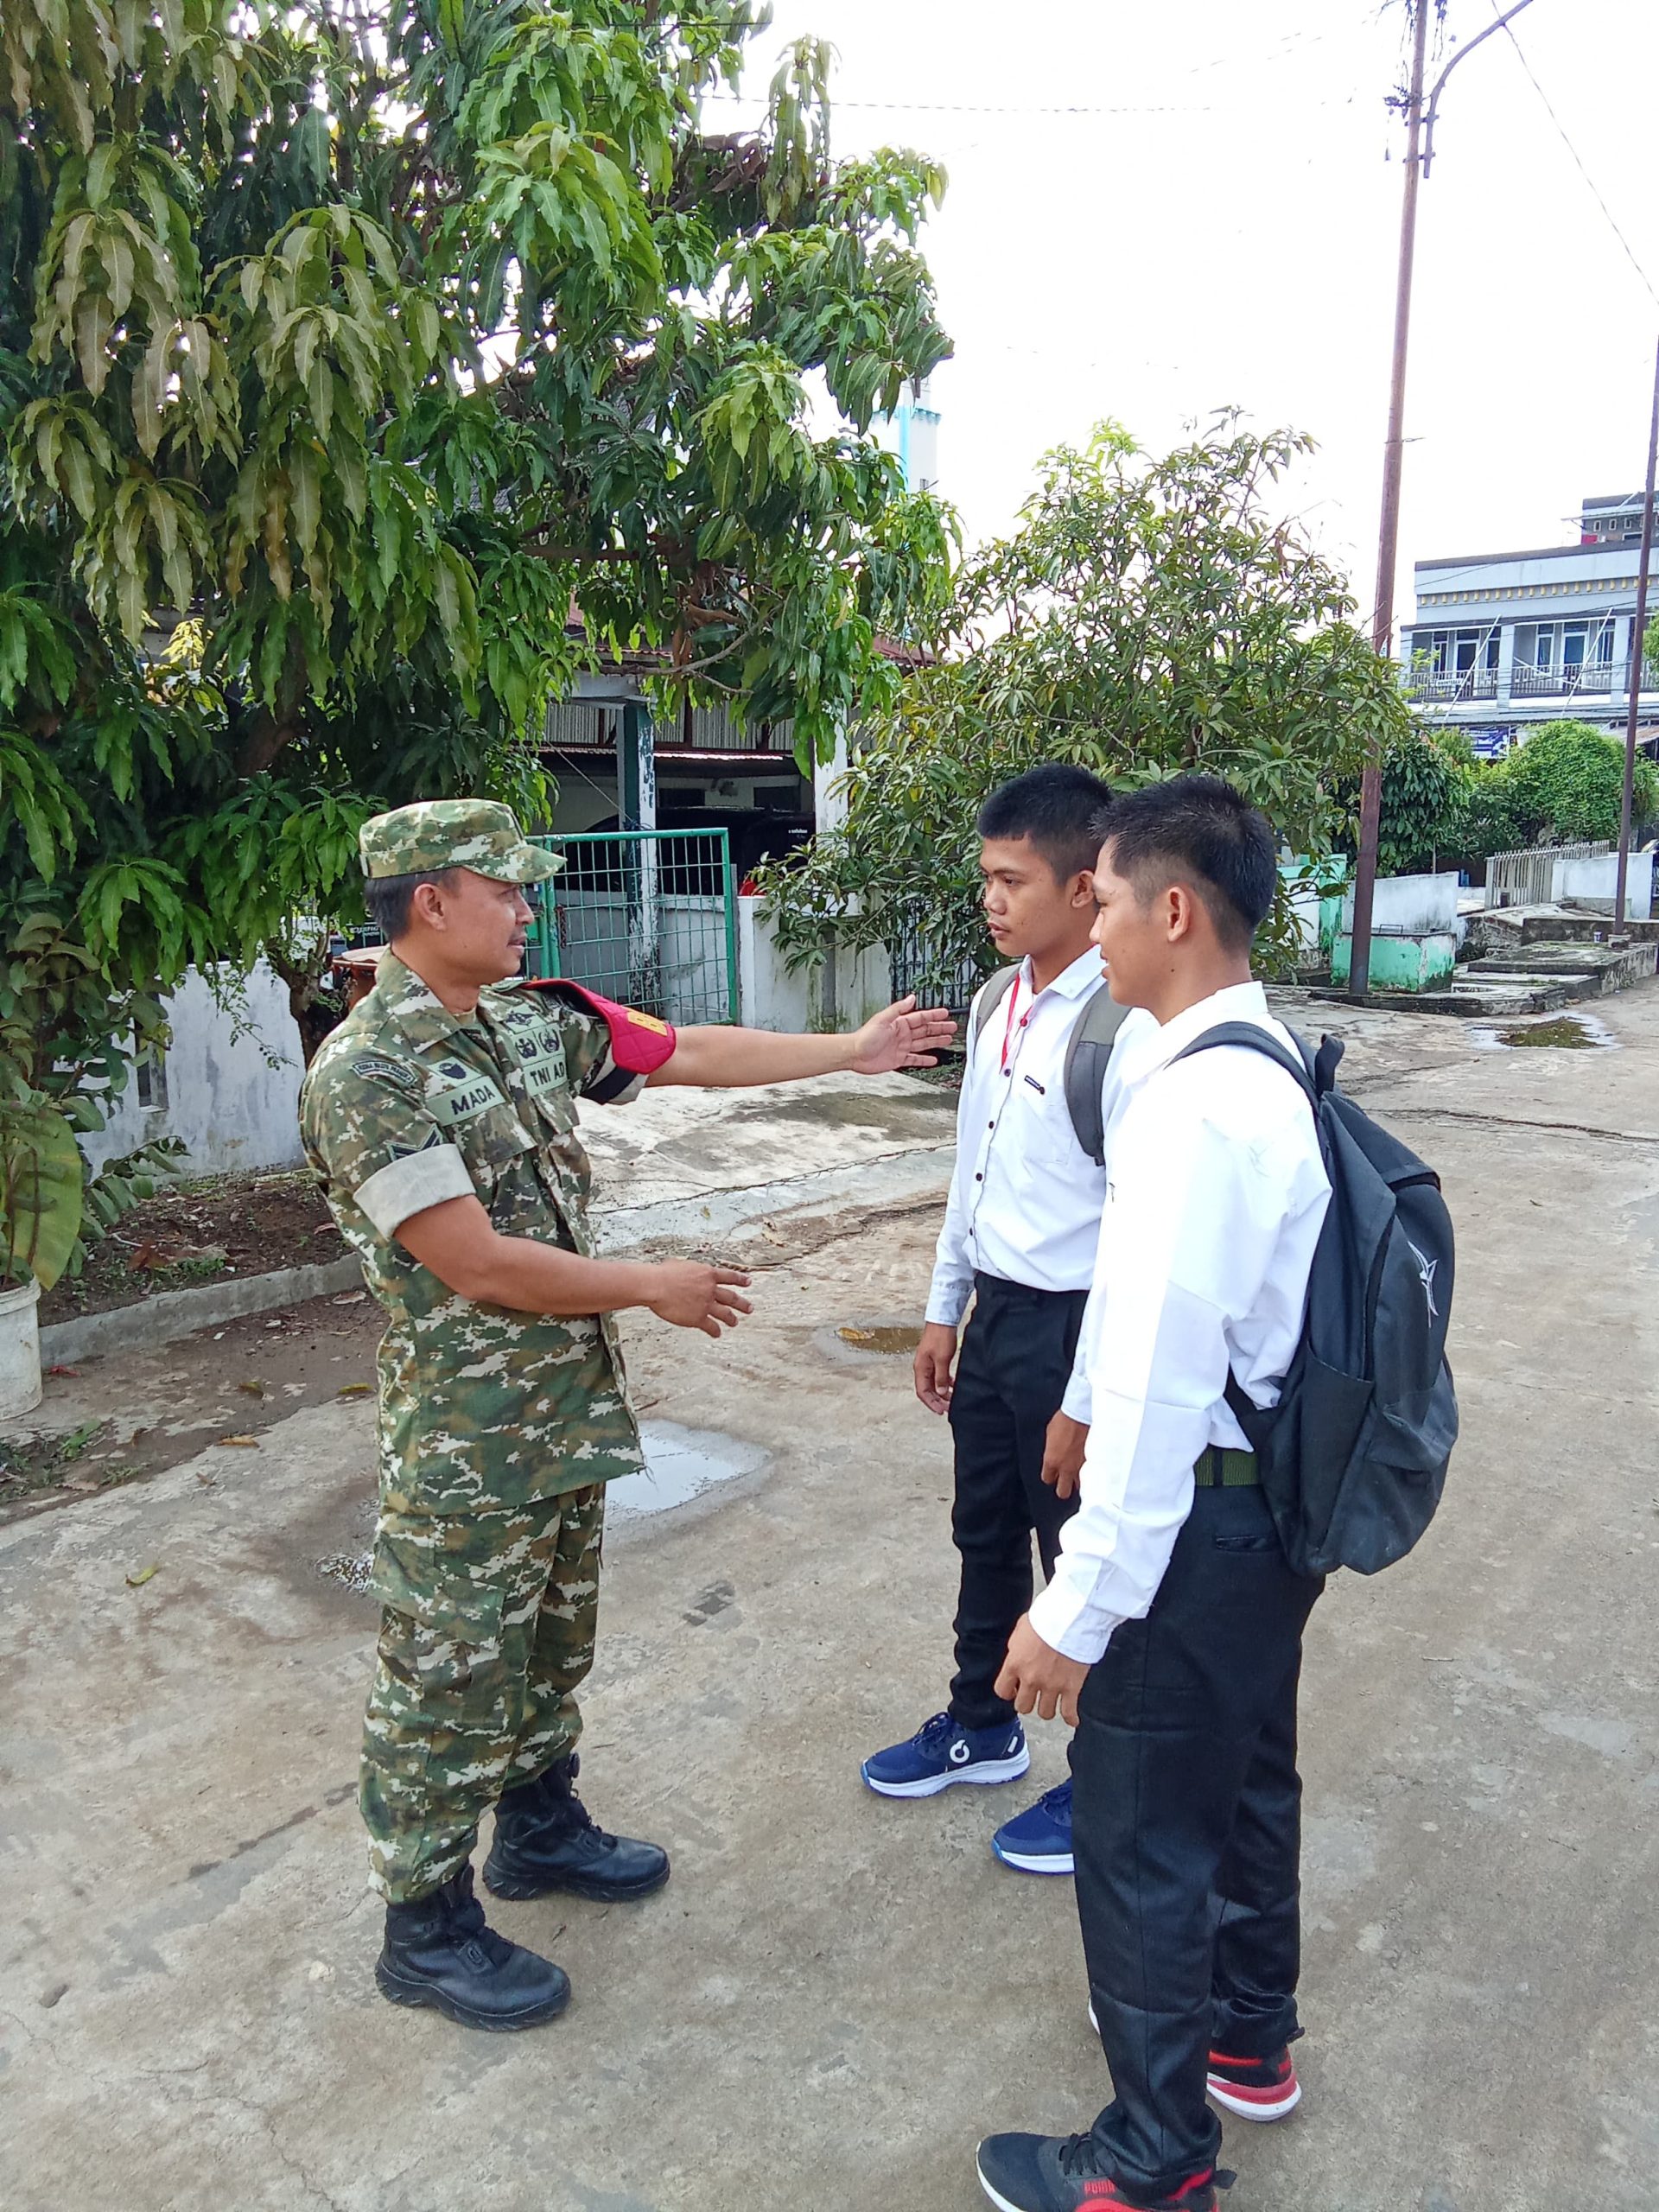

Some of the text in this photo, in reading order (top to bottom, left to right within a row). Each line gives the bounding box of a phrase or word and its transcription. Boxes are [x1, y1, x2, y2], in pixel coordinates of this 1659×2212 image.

[530, 1062, 565, 1087] TNI AD
[450, 1085, 496, 1116] MADA
[1083, 2178, 1116, 2195] PUMA
